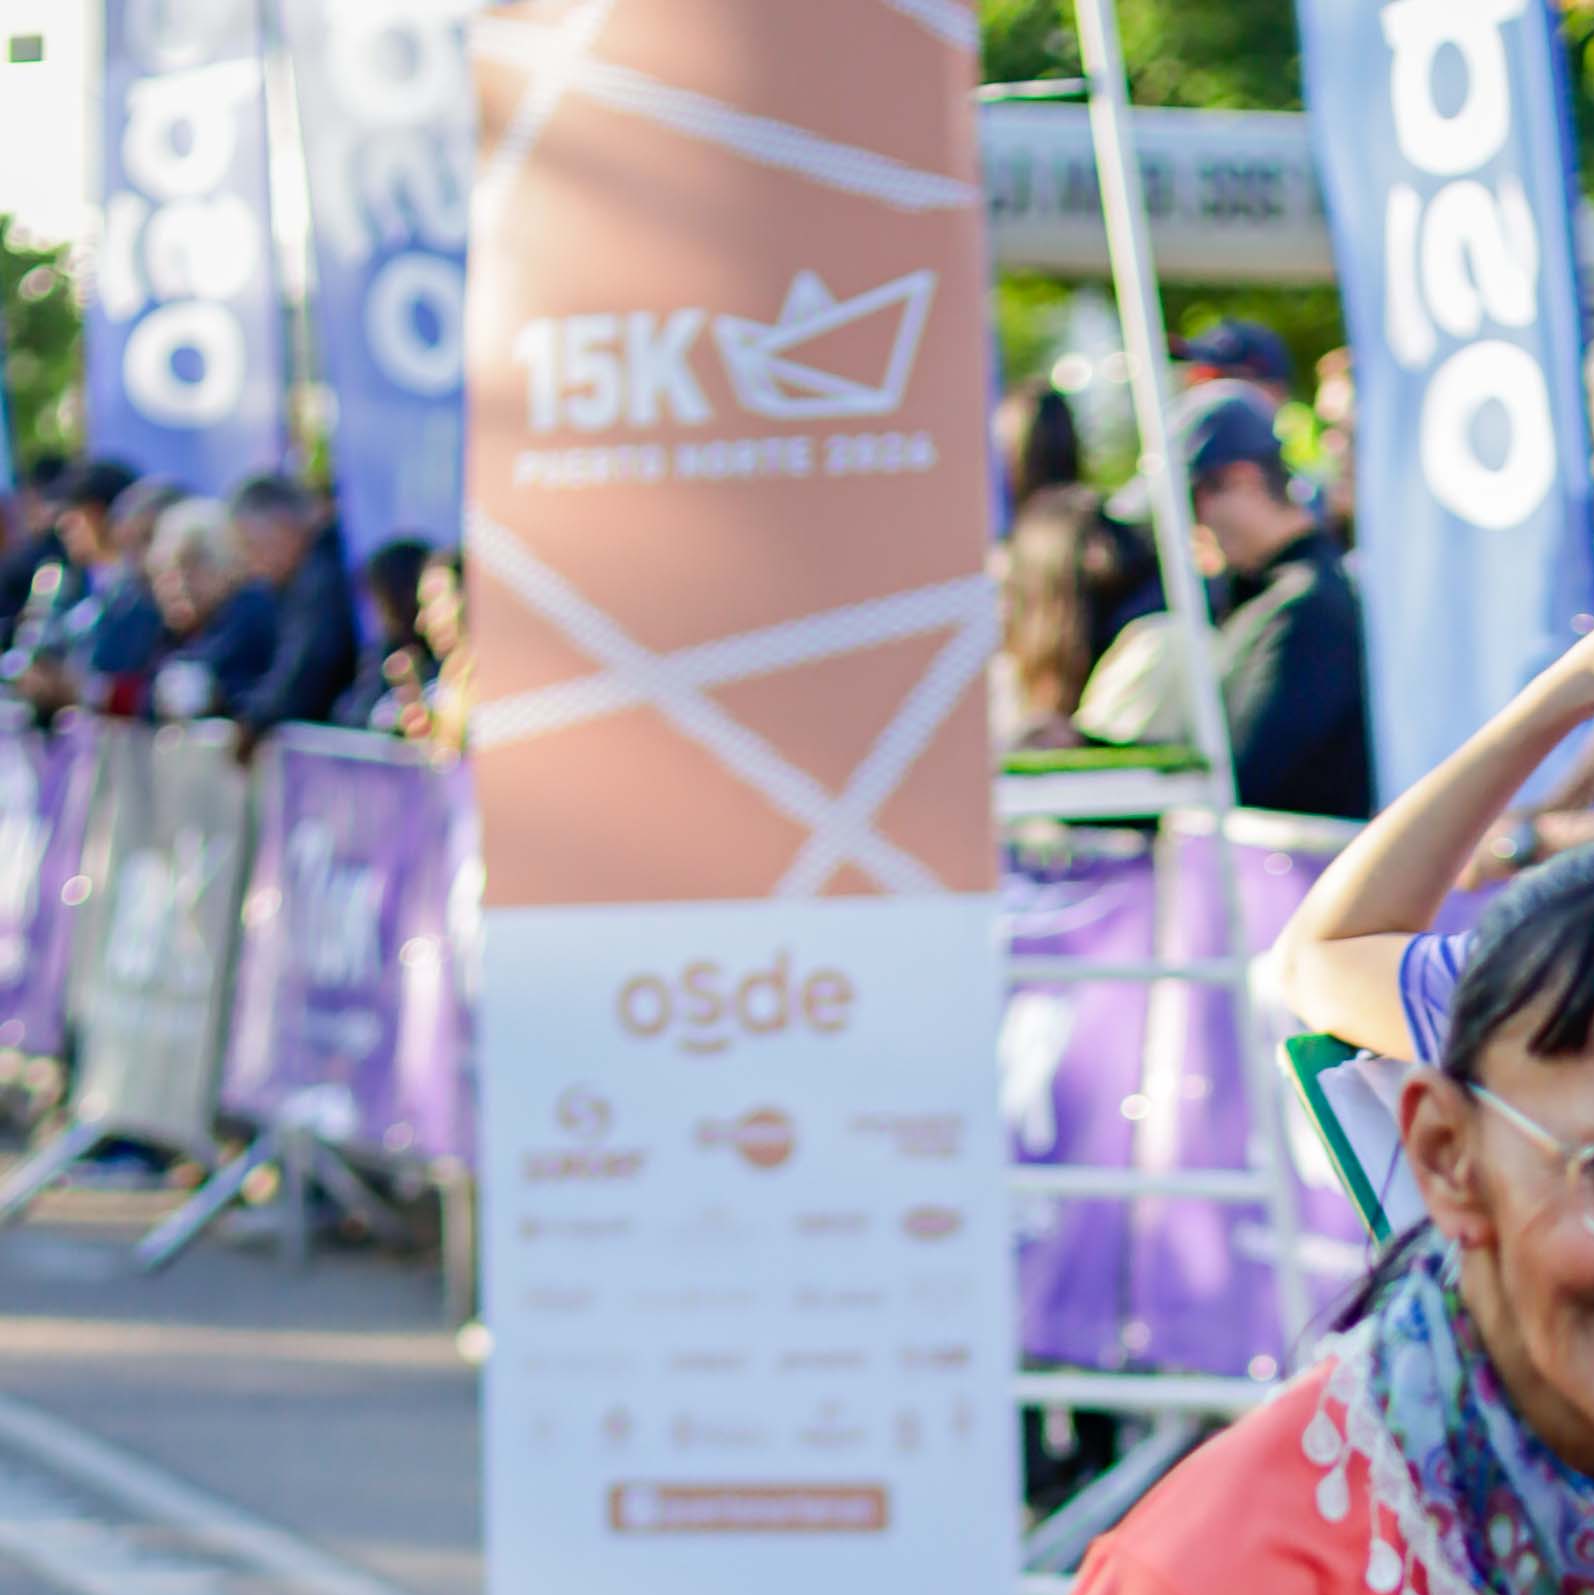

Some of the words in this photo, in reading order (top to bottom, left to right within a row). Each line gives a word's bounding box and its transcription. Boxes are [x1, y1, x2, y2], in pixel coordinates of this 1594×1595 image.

[512, 307, 714, 433] 15K
[674, 436, 813, 479] NORTE
[617, 948, 854, 1053] osde
